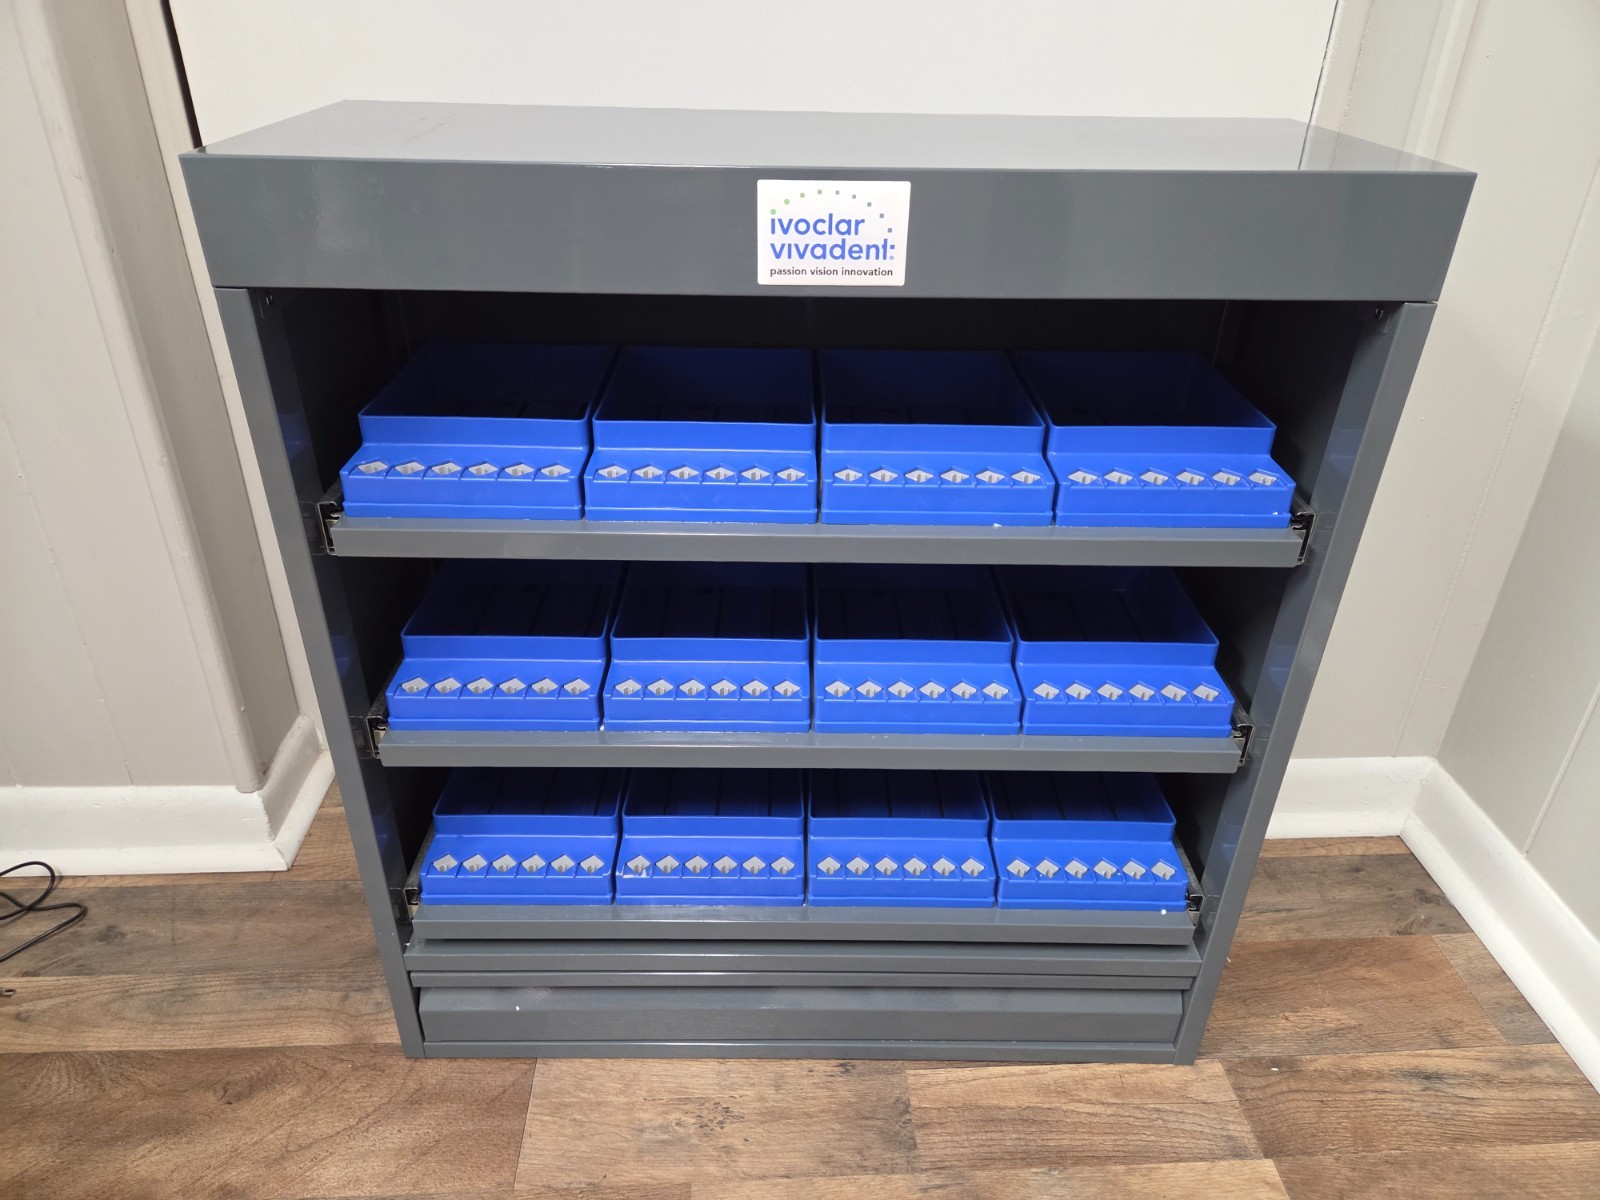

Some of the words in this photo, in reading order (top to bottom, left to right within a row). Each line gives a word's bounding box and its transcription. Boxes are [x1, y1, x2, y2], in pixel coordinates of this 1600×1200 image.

[770, 209, 865, 235] ivoclar
[770, 267, 807, 277] passion
[810, 267, 838, 276] vision
[841, 267, 893, 276] innovation
